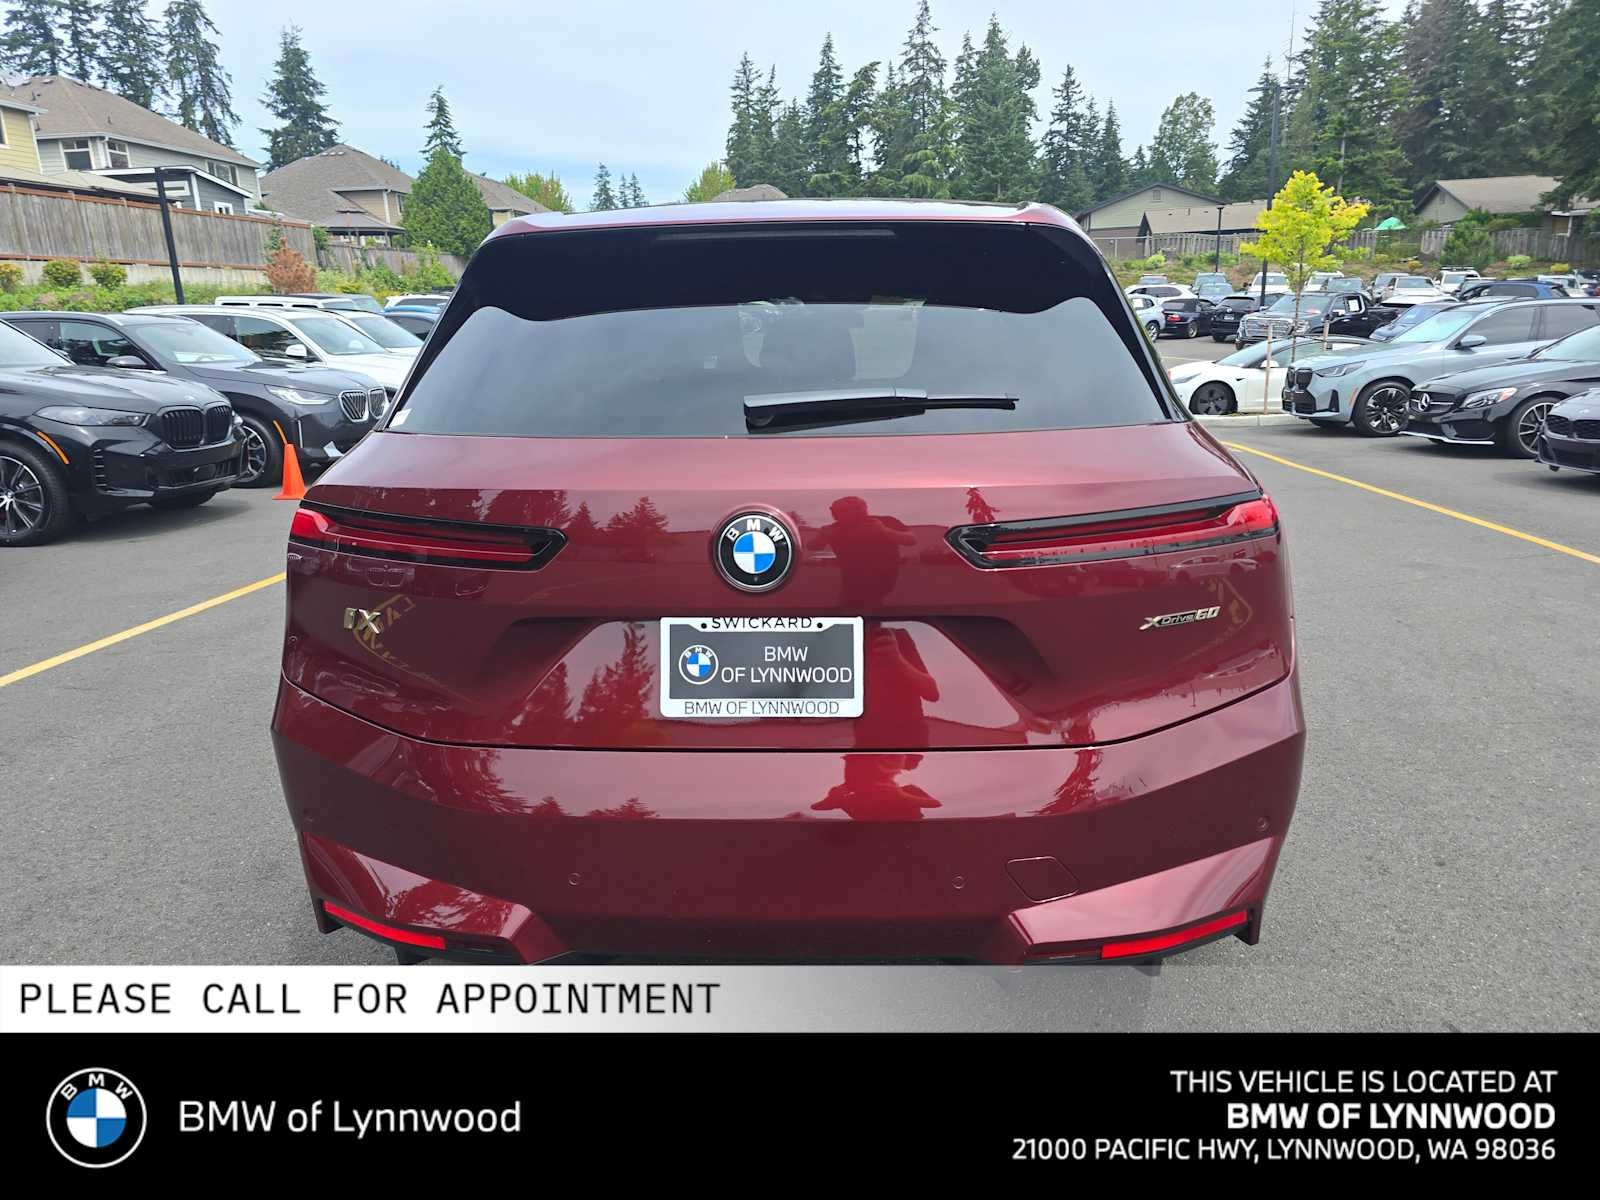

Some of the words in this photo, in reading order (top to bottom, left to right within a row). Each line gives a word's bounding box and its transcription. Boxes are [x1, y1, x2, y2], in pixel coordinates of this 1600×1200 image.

[726, 518, 784, 542] BMW
[711, 616, 813, 630] SWICKARD
[684, 646, 713, 659] BMW
[764, 646, 809, 662] BMW
[721, 667, 746, 683] OF
[750, 667, 853, 683] LYNNWOOD
[684, 701, 722, 715] BMW
[726, 701, 748, 715] OF
[752, 701, 840, 715] LYNNWOOD
